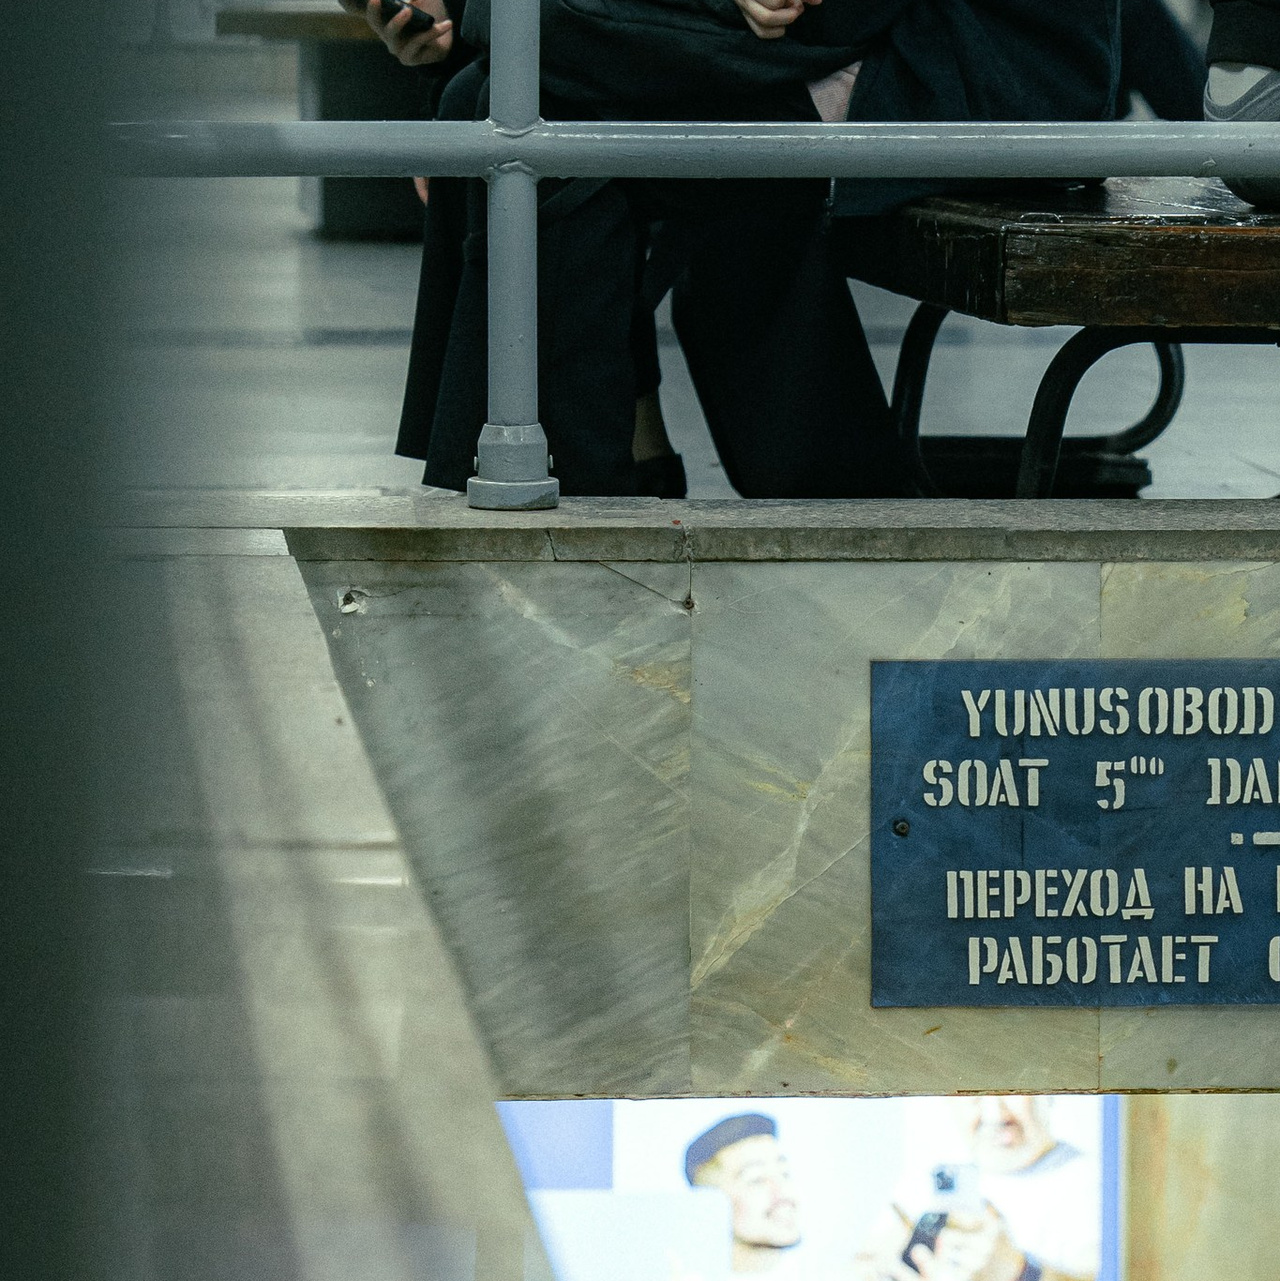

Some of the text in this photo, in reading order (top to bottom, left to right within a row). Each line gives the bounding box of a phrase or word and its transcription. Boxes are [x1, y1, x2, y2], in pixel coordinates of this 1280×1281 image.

[961, 687, 1274, 736] YUNUSOBOD
[923, 758, 1049, 807] SOAT
[946, 868, 1155, 920] ПЕРЕХОД
[1184, 866, 1244, 915] НА
[968, 934, 1219, 985] РАБОТАЕТ
